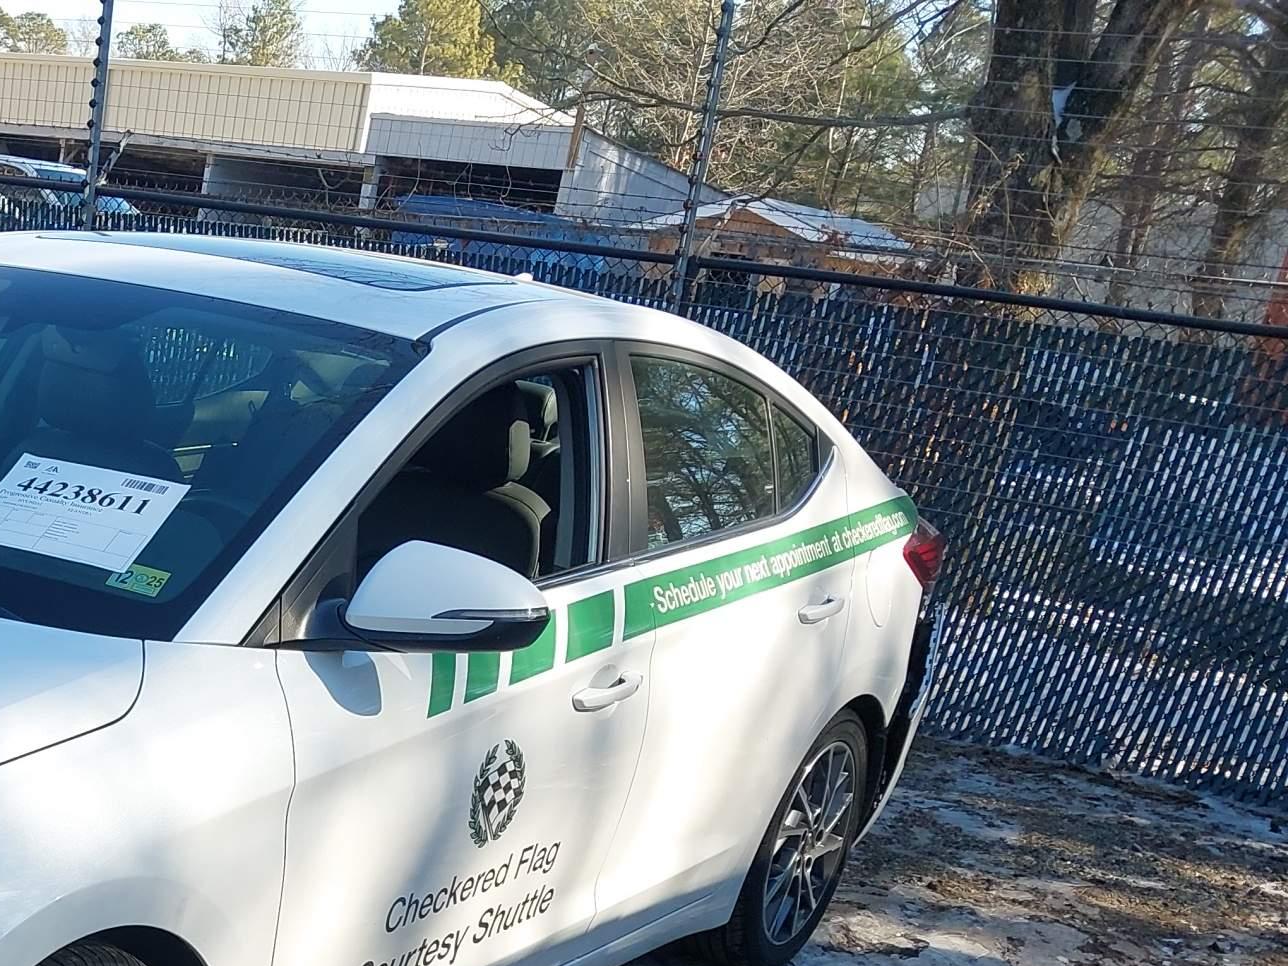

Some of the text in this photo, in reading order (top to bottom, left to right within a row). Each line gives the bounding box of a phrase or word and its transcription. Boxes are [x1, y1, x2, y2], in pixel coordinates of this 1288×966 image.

[17, 477, 152, 515] 44238611
[115, 571, 165, 588] 12 25
[653, 573, 716, 614] Schedule
[716, 566, 744, 600] your
[744, 559, 770, 584] next
[770, 534, 833, 578] appointment
[832, 531, 843, 552] at
[385, 840, 562, 933] Checkered Flag
[472, 884, 555, 944] Shuttle
